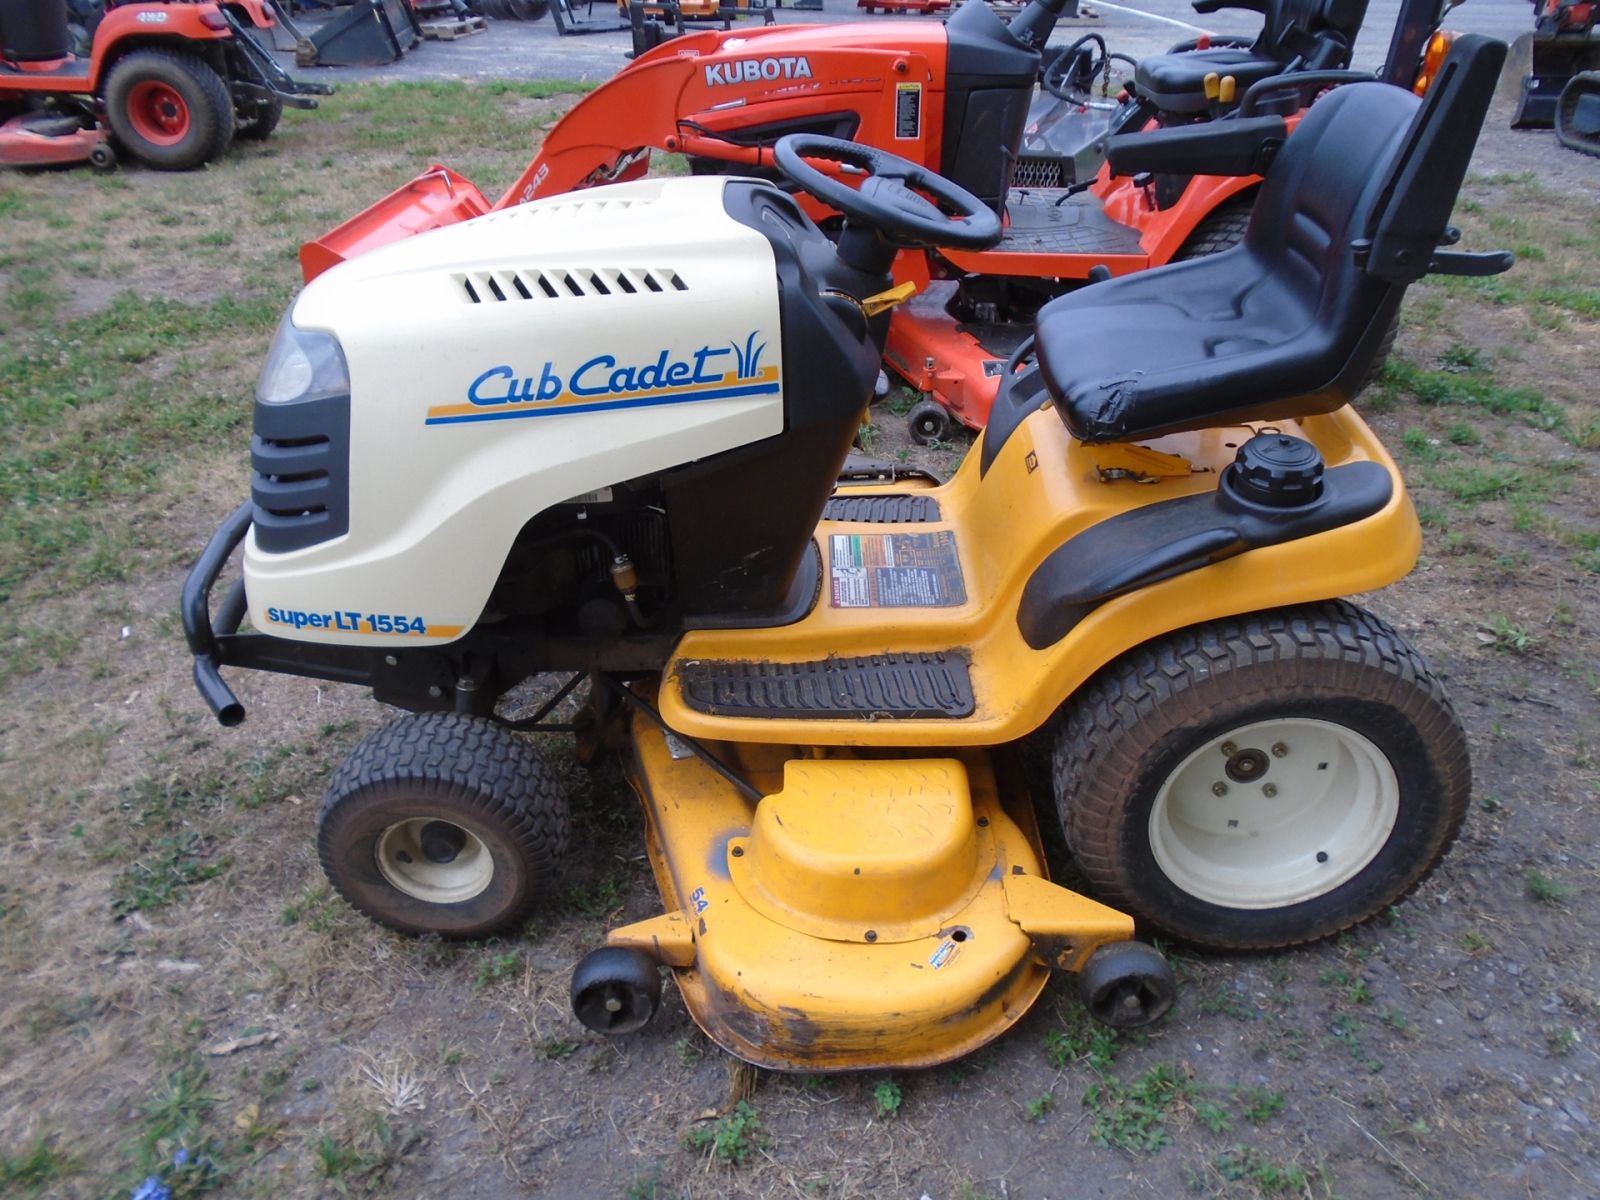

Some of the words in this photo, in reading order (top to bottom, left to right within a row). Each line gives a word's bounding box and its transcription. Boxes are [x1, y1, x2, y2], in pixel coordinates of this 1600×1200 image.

[704, 56, 812, 87] KUBOTA
[467, 362, 563, 406] Cub
[569, 346, 732, 396] Cadet
[366, 613, 426, 634] 1554
[692, 886, 709, 914] 54
